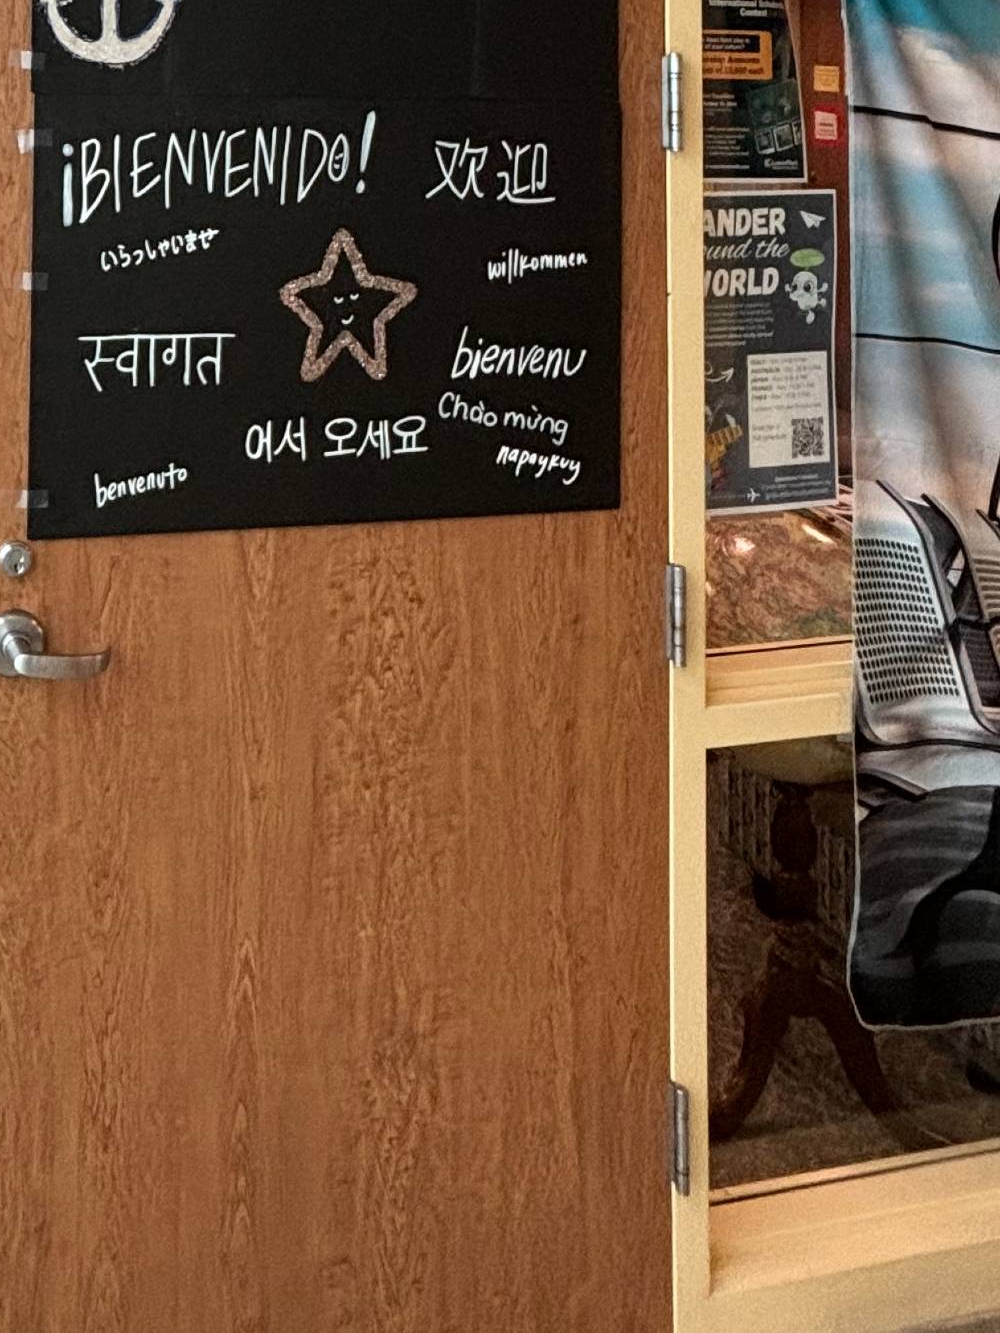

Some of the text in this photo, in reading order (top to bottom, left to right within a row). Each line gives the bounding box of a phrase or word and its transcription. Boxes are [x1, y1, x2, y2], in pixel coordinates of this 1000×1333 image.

[425, 137, 556, 205] 欢迎
[703, 207, 786, 237] ANDER
[100, 227, 220, 272] いらっしゃいませ
[487, 248, 588, 285] willkommen
[755, 237, 790, 259] the
[78, 332, 236, 392] स्वागत
[451, 325, 587, 380] bienvenu
[438, 392, 498, 427] Chào
[245, 415, 429, 463] 어서 오세요
[94, 464, 187, 508] benvenuto
